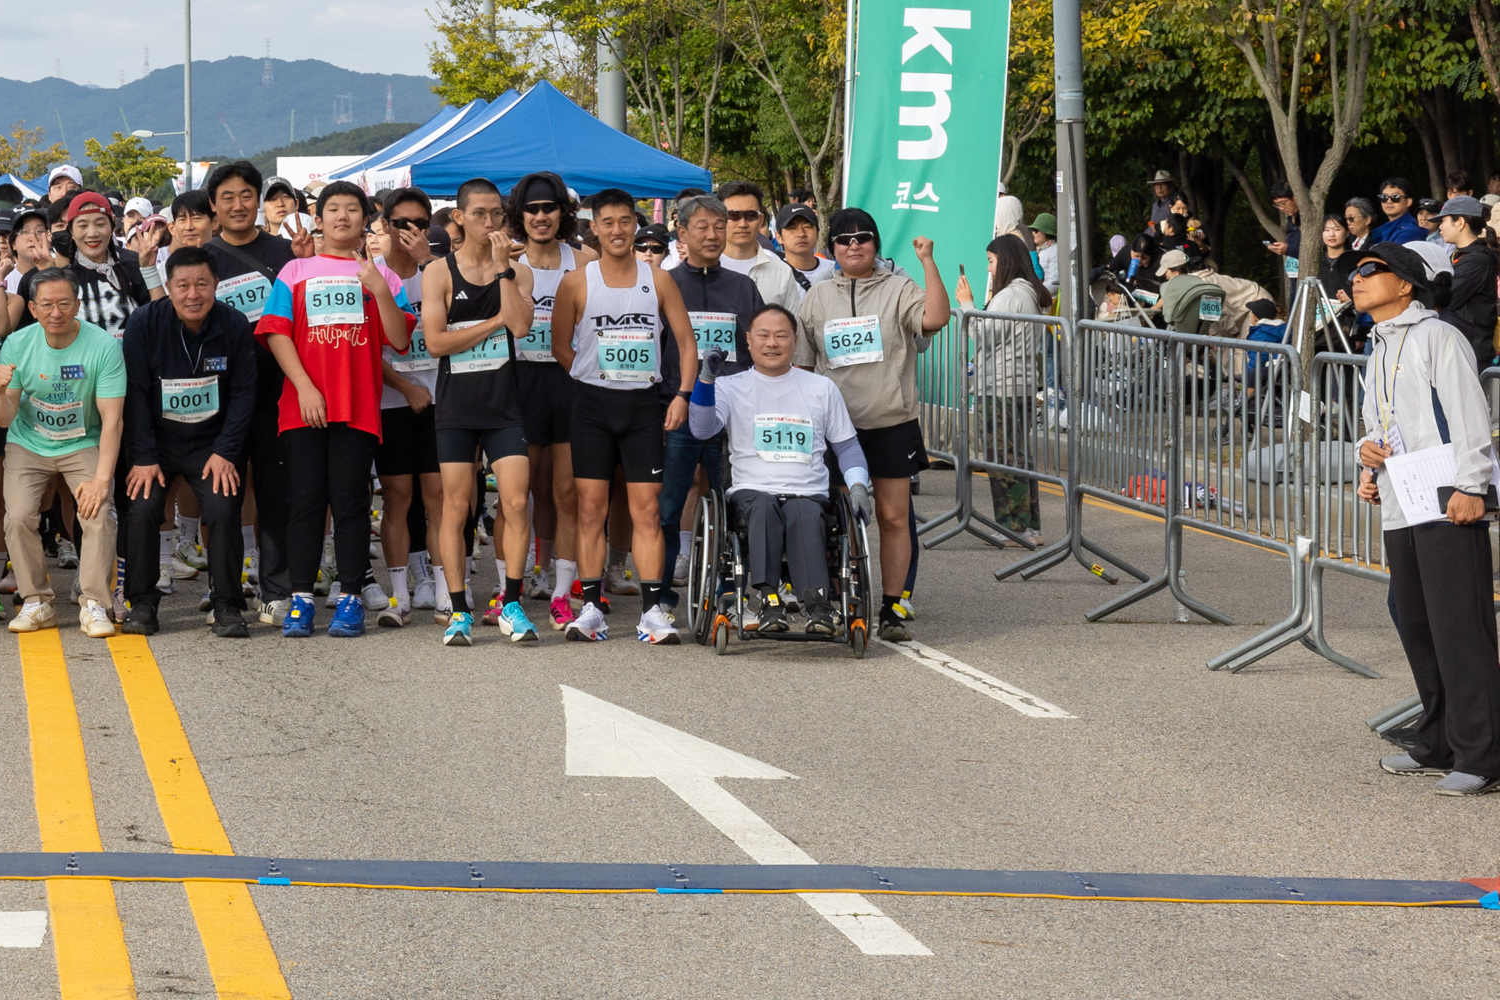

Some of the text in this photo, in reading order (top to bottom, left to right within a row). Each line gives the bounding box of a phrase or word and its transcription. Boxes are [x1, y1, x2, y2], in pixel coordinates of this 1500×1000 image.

[892, 181, 940, 213] 코스
[225, 285, 266, 308] 5197
[313, 292, 356, 307] 5198
[693, 328, 733, 343] 5123
[831, 331, 875, 349] 5624
[605, 348, 649, 363] 5005
[170, 391, 210, 409] 0001
[36, 411, 78, 427] 0002
[762, 430, 806, 446] 5119
